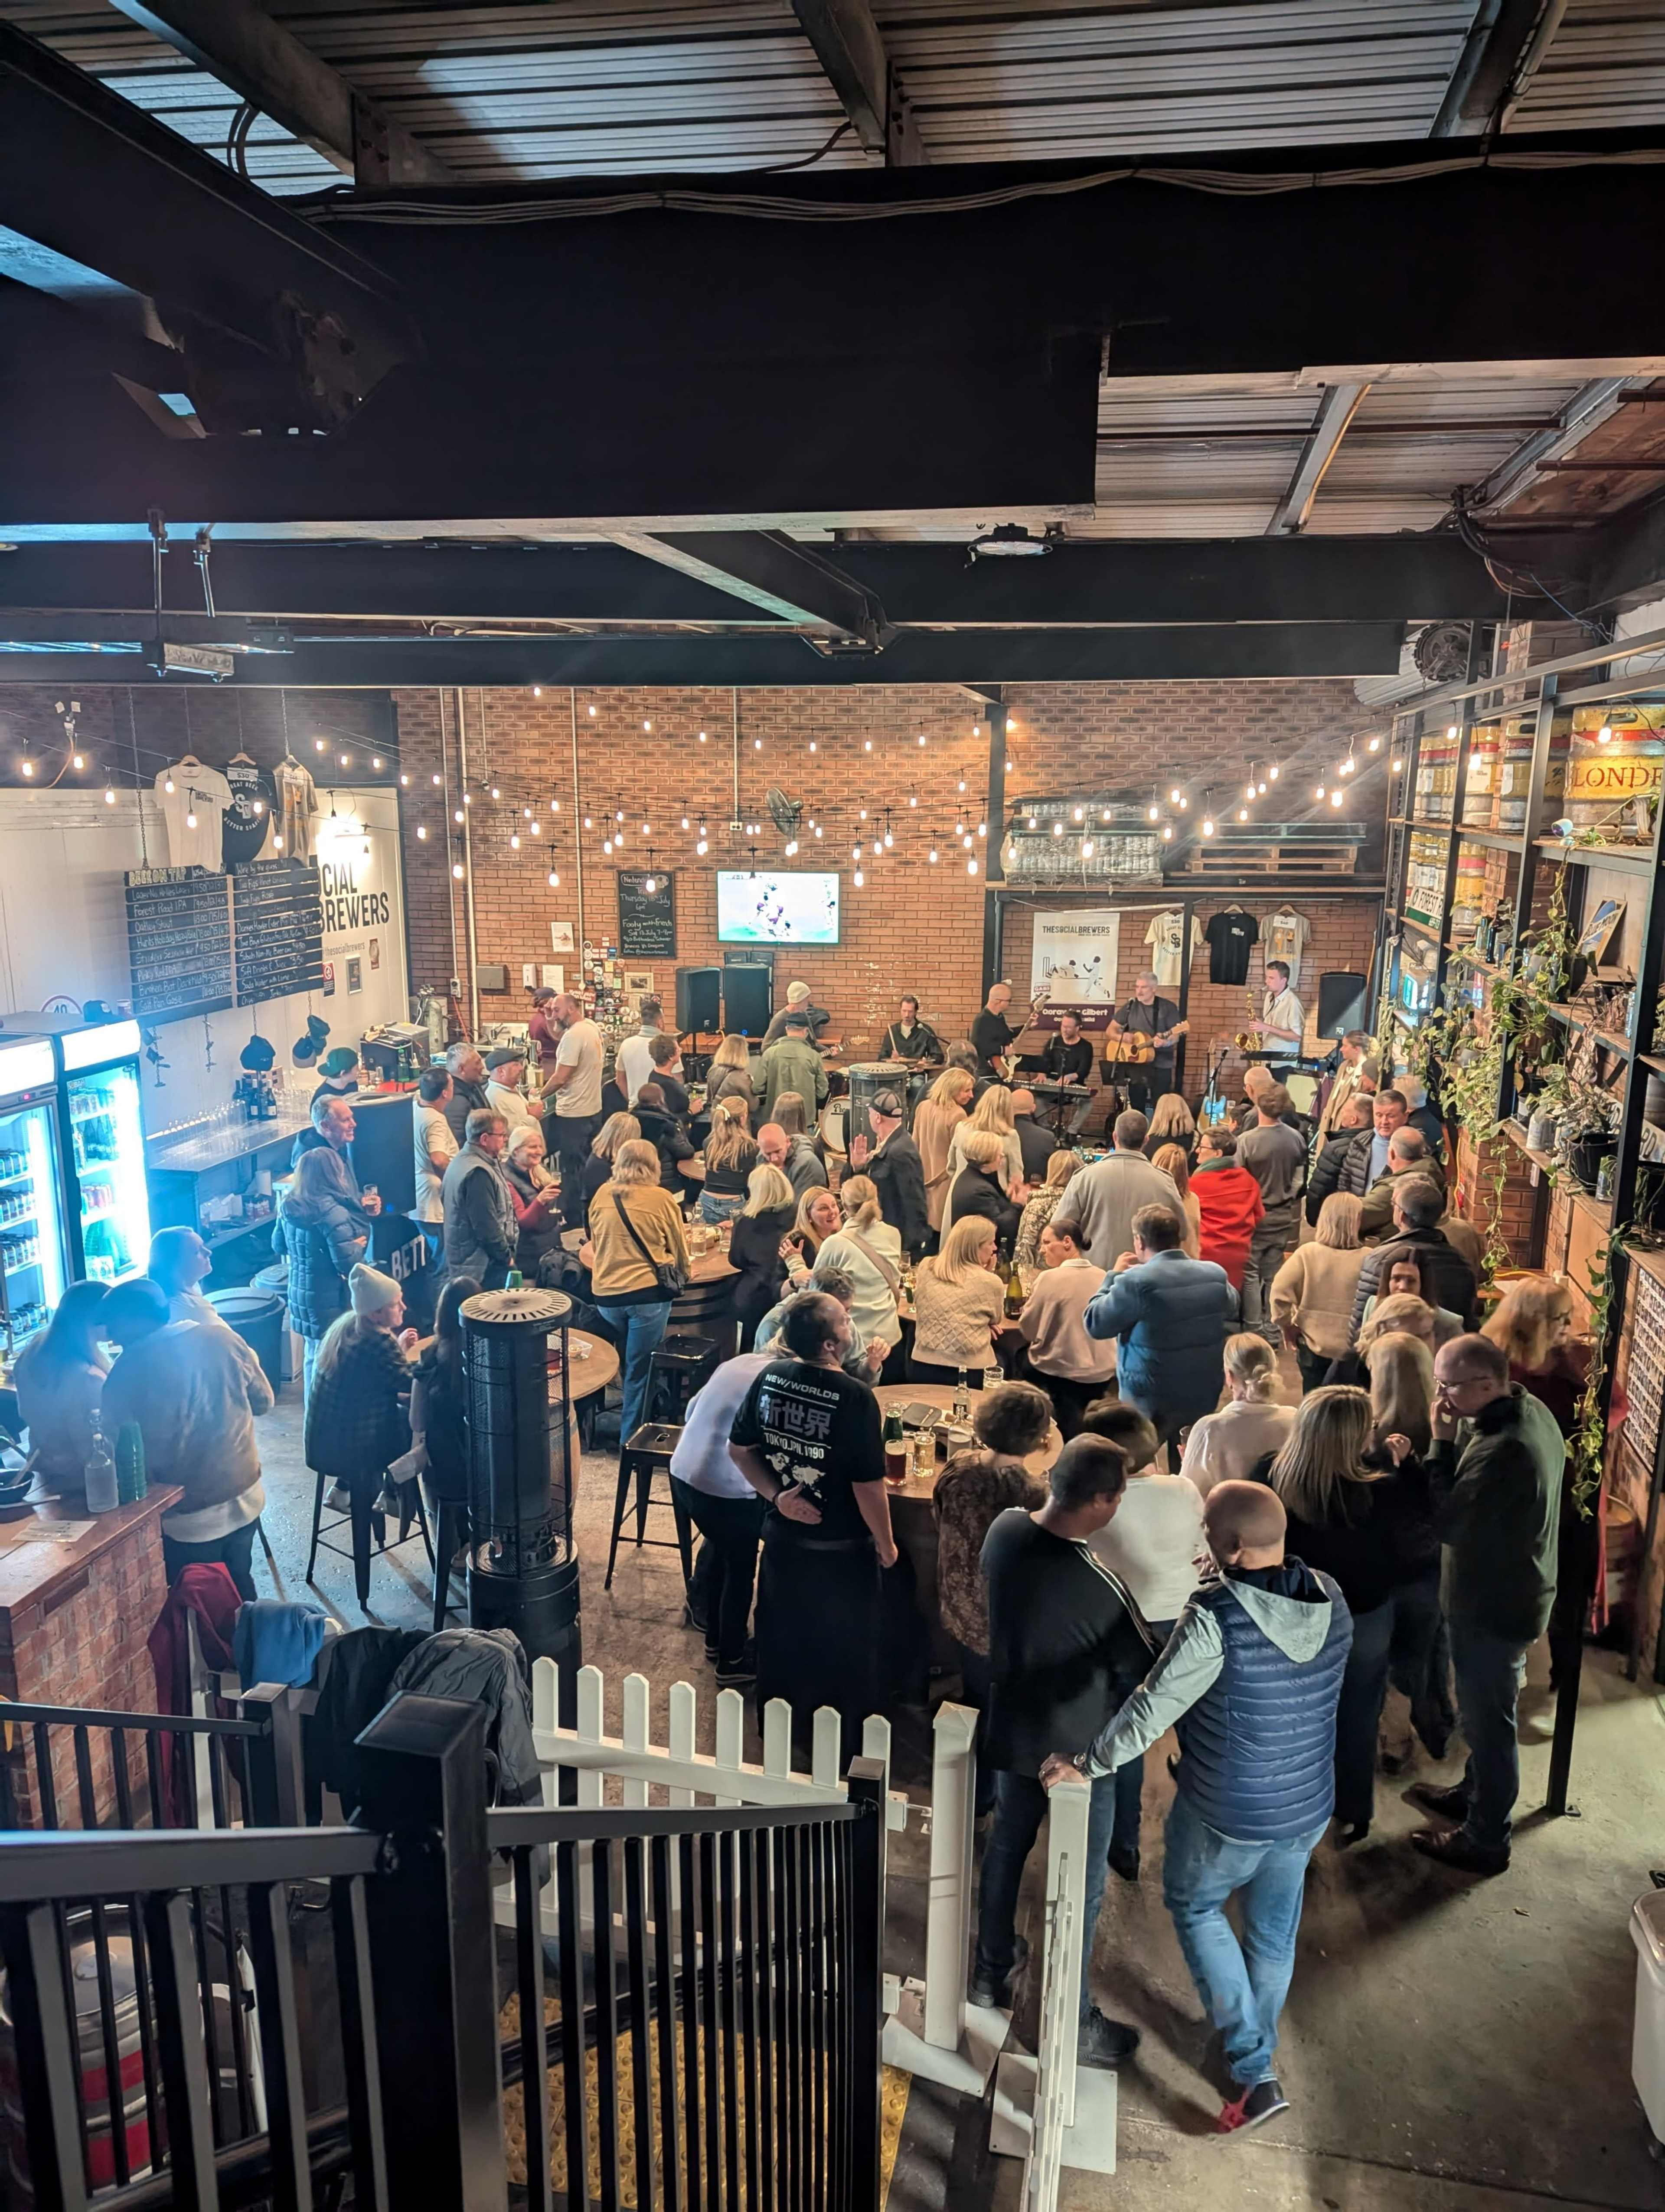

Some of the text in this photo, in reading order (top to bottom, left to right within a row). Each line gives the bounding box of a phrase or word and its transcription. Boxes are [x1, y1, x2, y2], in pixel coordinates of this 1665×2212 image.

[168, 867, 187, 882] TAP
[317, 862, 358, 897] CIAL
[620, 893, 648, 905] Thursday
[656, 895, 670, 908] July
[1420, 890, 1439, 917] FOREST
[134, 904, 155, 918] Forest
[622, 918, 642, 931] Footy
[1042, 925, 1110, 934] THESOCIALBREWERS
[322, 941, 366, 957] thesocialbrewers
[764, 1373, 840, 1401] NEW/WORLDS
[759, 1393, 831, 1440] 新世界
